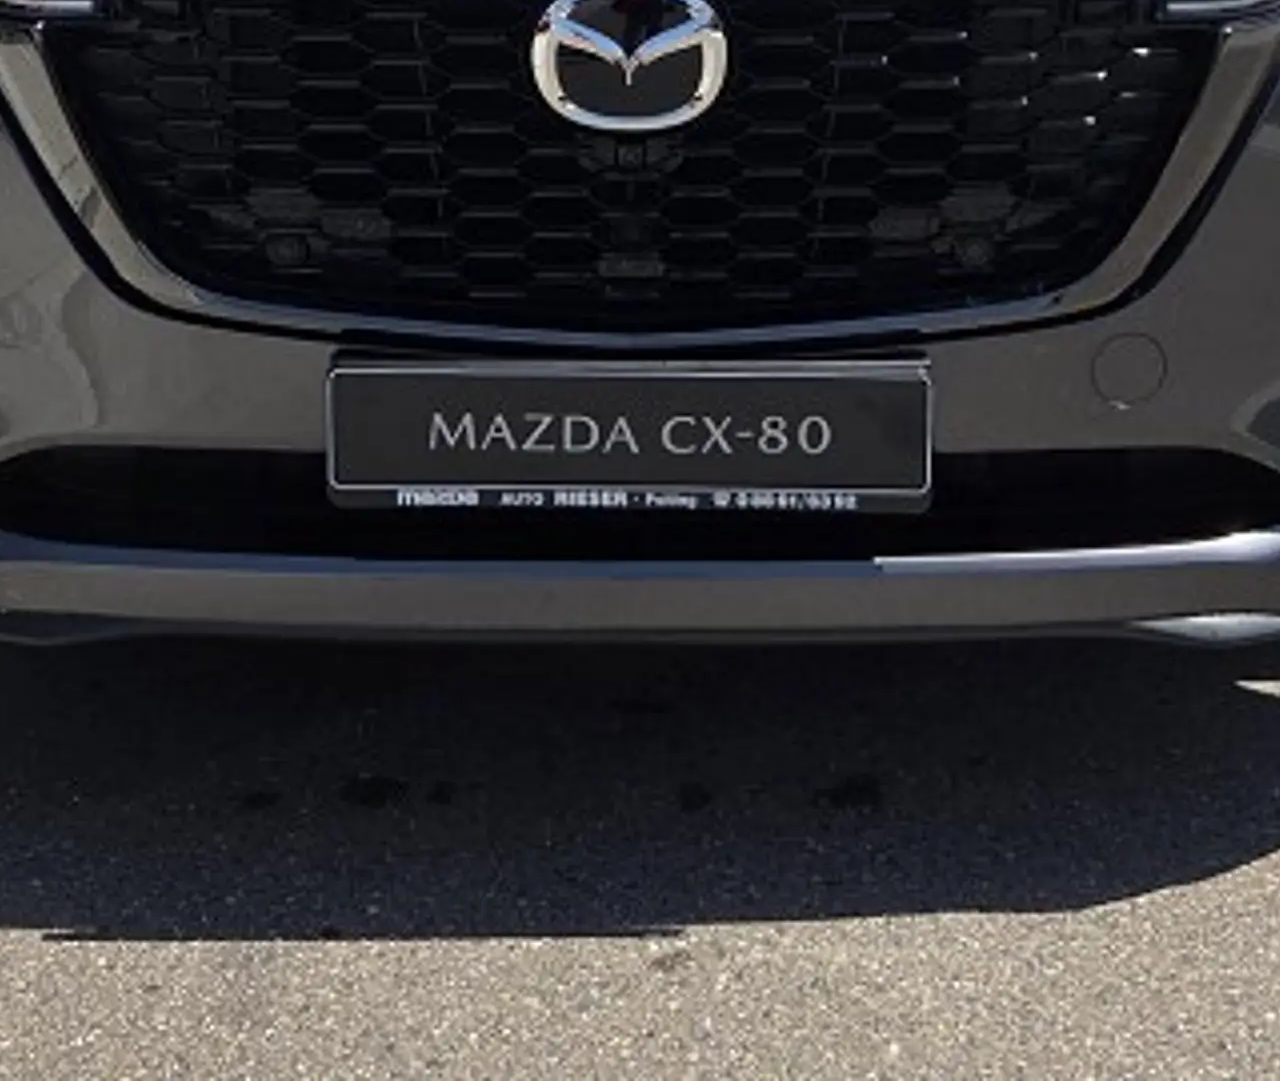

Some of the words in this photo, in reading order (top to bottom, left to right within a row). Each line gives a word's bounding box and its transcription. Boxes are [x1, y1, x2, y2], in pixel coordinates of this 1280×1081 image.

[428, 412, 640, 455] MAZDA
[660, 415, 831, 455] CX-80
[501, 492, 545, 506] AUTO
[554, 491, 627, 506] RIESER
